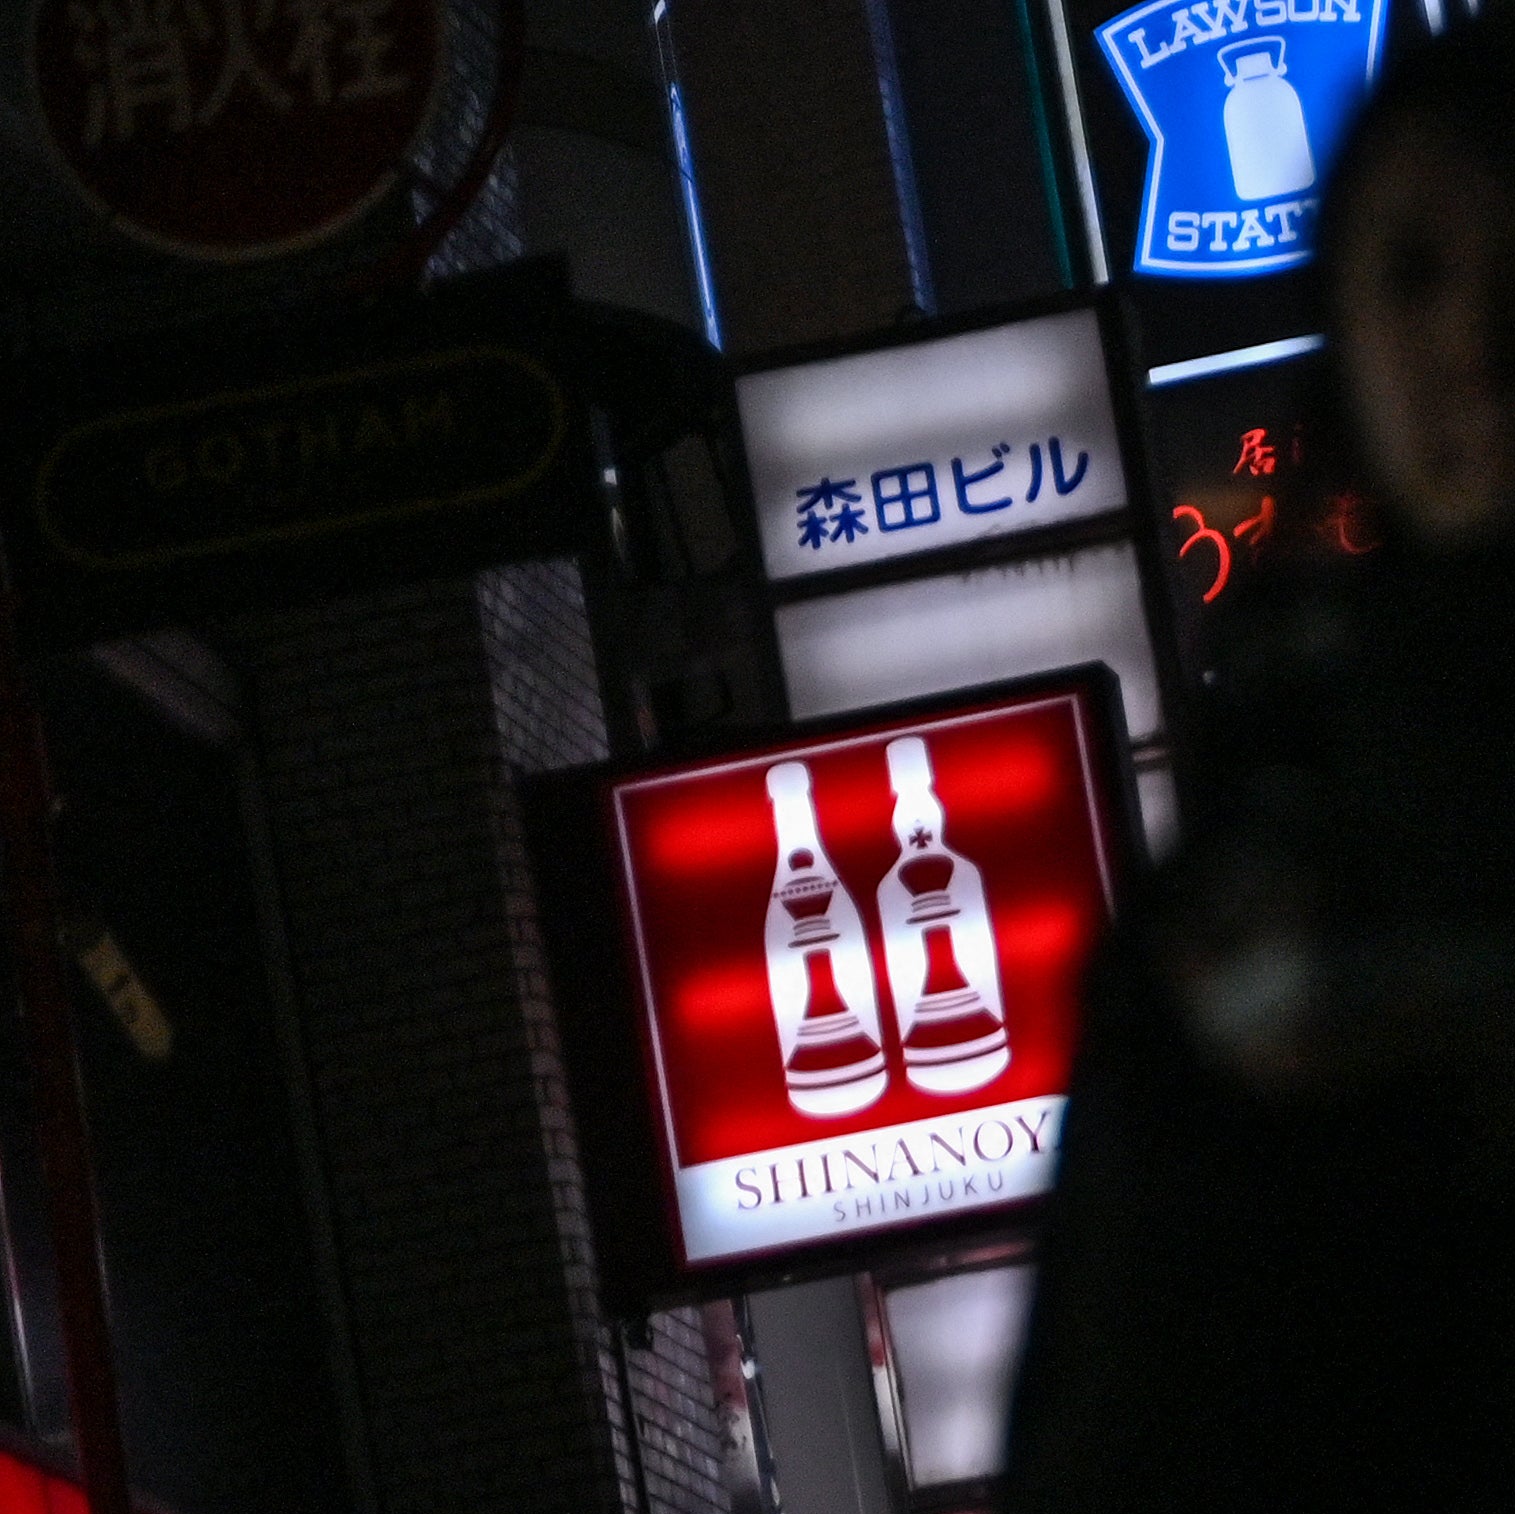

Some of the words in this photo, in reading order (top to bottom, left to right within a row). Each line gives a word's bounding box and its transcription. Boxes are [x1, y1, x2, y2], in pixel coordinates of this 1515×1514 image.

[1129, 0, 1362, 69] LAWSON
[1167, 202, 1303, 251] STAT
[797, 437, 1090, 551] 森田ビル
[735, 1110, 1051, 1211] SHINANOY
[832, 1173, 1006, 1222] SHINJUKU
